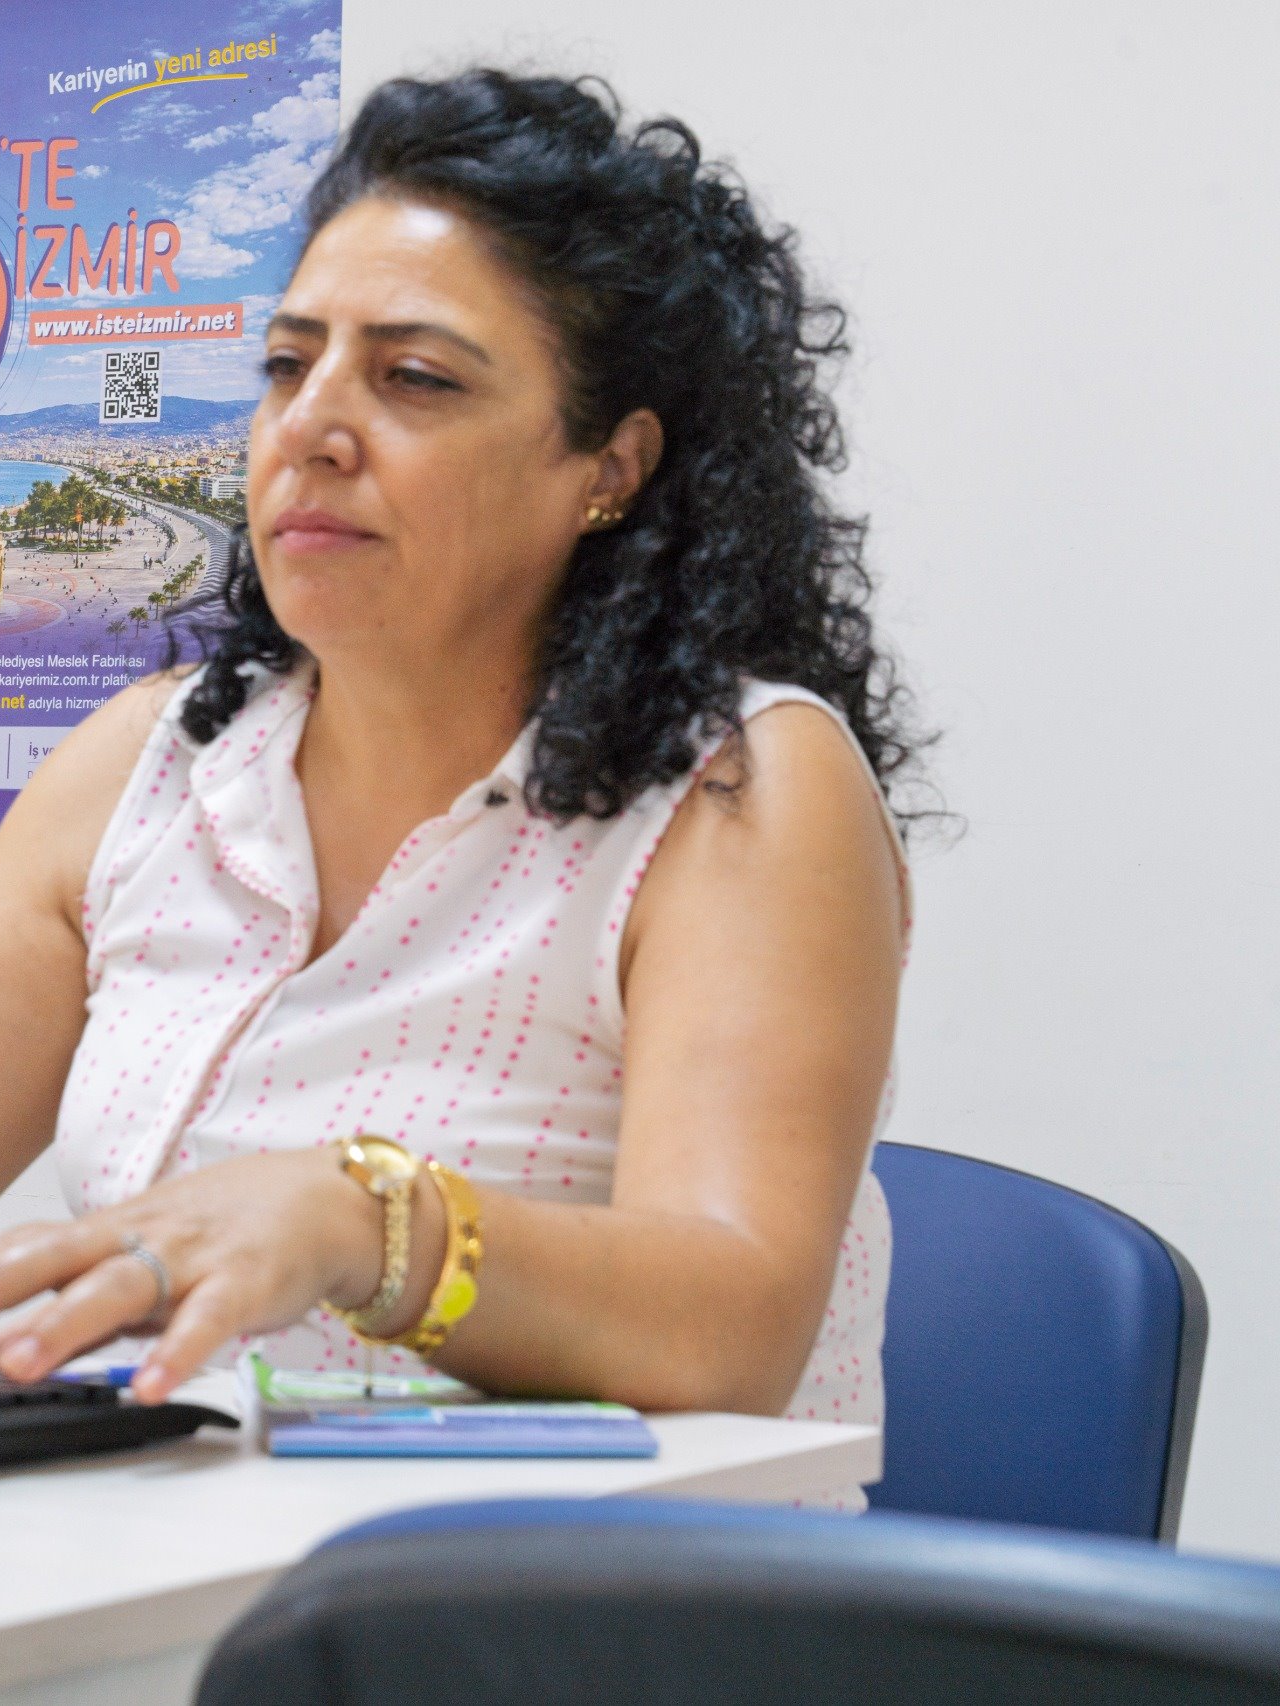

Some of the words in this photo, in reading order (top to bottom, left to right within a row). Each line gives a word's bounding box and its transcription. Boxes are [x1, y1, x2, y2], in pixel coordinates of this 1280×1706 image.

[49, 58, 148, 95] Kariyerin
[154, 47, 202, 82] yeni
[208, 32, 278, 67] adresi
[14, 207, 182, 300] İZMİR
[34, 310, 236, 338] www.isteizmir.net
[47, 654, 89, 668] Meslek
[92, 654, 146, 668] Fabrikası
[28, 696, 63, 712] adıyla
[29, 741, 39, 760] İş
